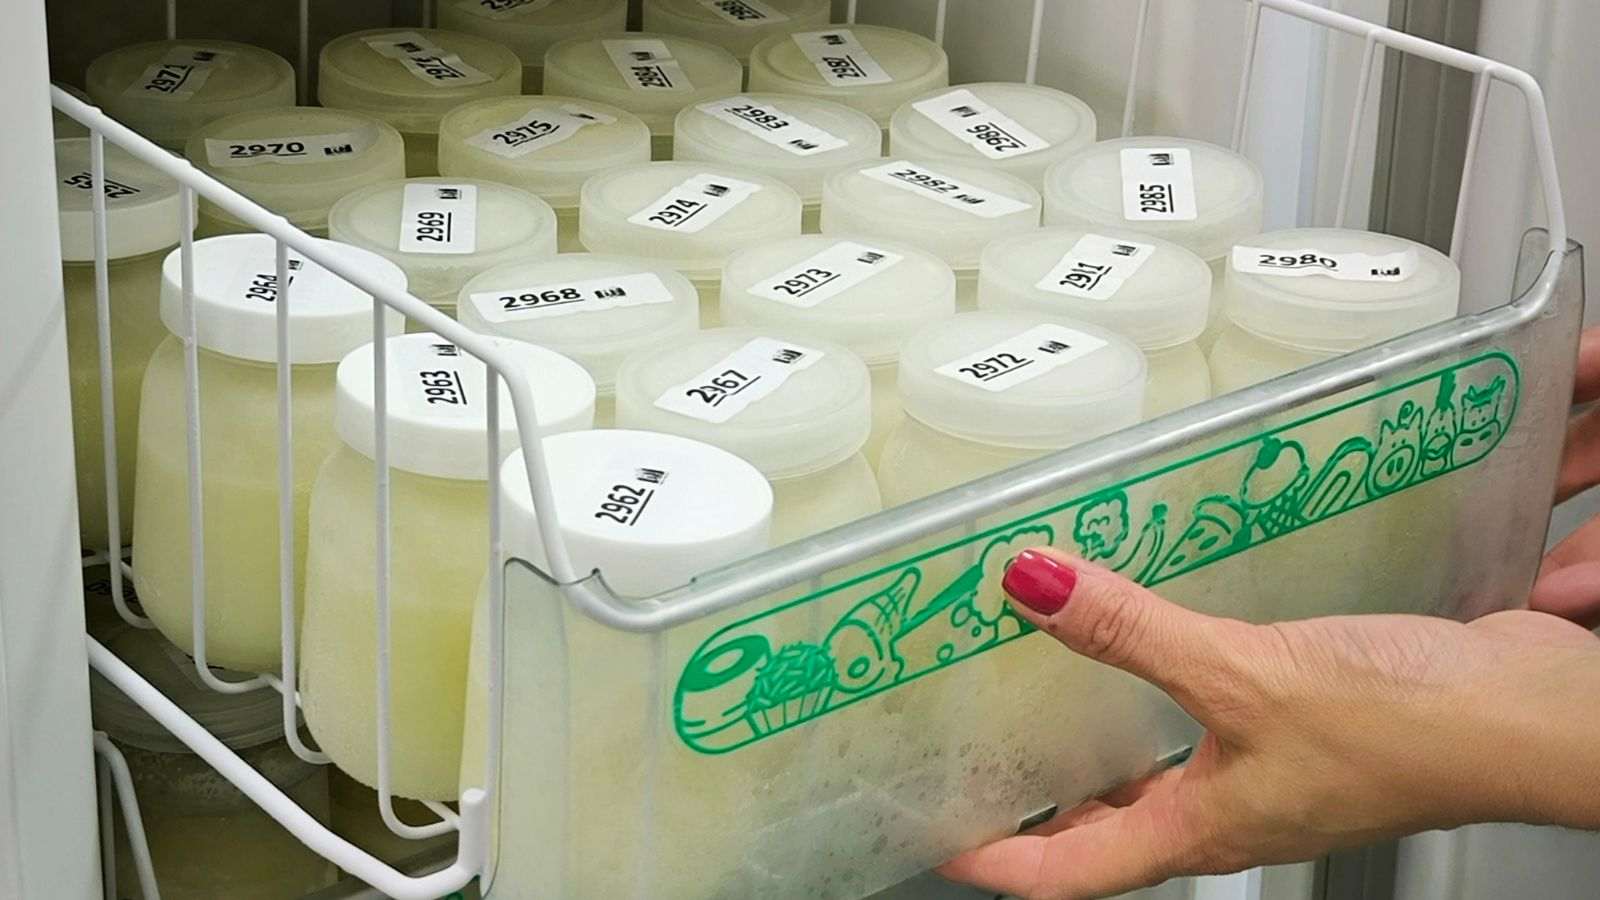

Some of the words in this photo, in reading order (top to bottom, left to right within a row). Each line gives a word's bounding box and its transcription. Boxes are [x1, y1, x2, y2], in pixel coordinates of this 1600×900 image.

[823, 56, 860, 78] 2987
[731, 104, 788, 130] 2983
[492, 120, 552, 146] 2975
[967, 124, 1020, 152] 2986
[230, 142, 304, 156] 2970
[895, 169, 959, 192] 2982
[649, 199, 701, 226] 2974
[1141, 184, 1167, 214] 2985
[416, 211, 444, 242] 2969
[1259, 254, 1338, 268] 2980
[773, 268, 833, 295] 2973
[499, 288, 581, 309] 2968
[959, 353, 1027, 380] 2972
[420, 370, 457, 405] 2963
[686, 370, 748, 403] 2967
[595, 483, 646, 525] 2962
